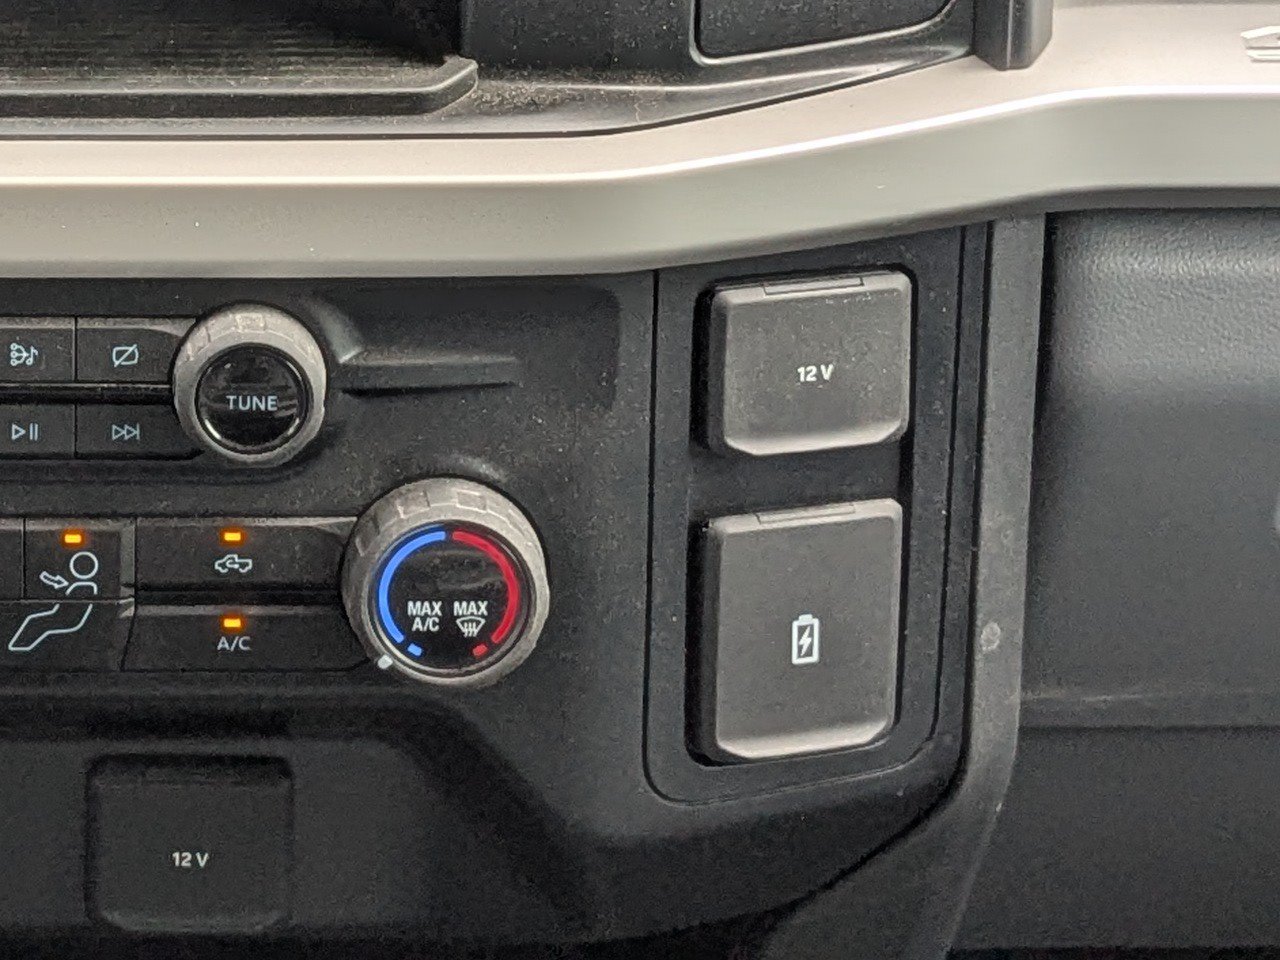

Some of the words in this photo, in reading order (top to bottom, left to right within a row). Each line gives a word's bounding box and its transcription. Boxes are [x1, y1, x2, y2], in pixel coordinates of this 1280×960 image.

[798, 365, 817, 382] 12
[819, 364, 833, 381] V
[226, 396, 278, 411] TUNE
[408, 601, 442, 616] MAX
[454, 601, 487, 616] MAX
[412, 616, 439, 632] A/C
[218, 636, 250, 651] A/C
[173, 852, 192, 868] 12
[196, 852, 209, 868] V
